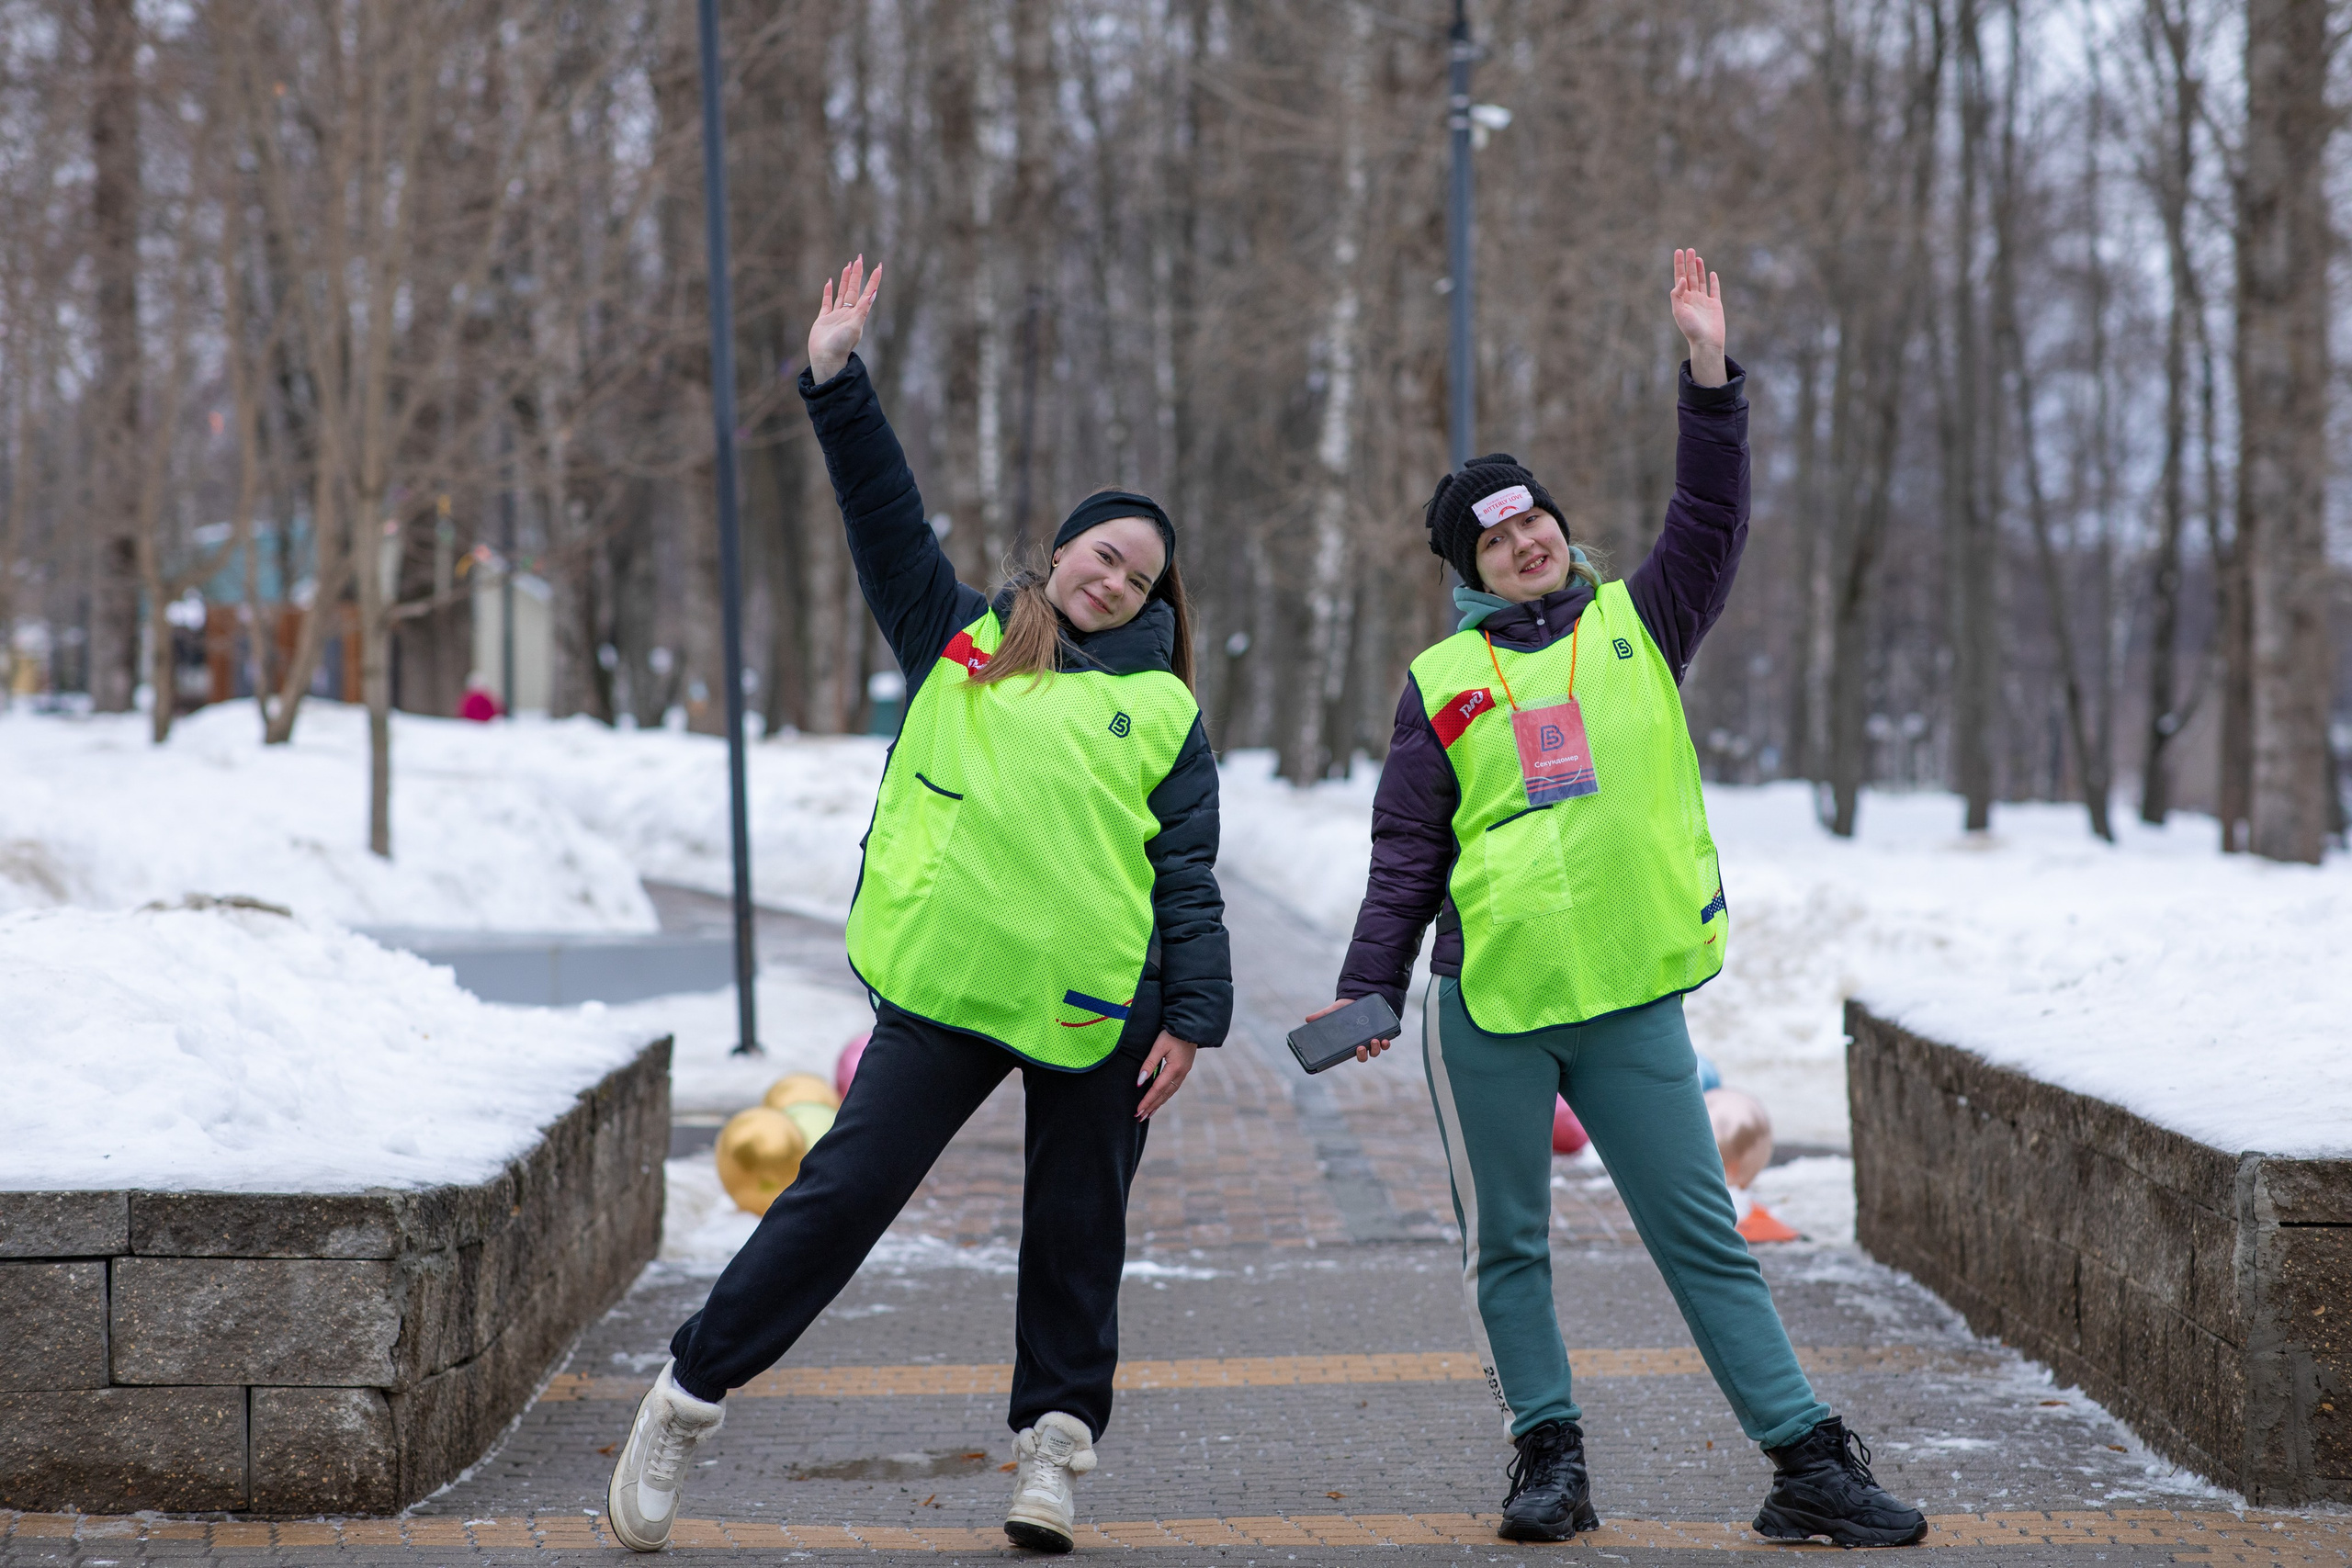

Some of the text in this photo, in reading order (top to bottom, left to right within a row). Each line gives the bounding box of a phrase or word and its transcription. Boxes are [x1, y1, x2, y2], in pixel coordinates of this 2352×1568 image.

[1483, 498, 1508, 514] BITTERLY
[1508, 493, 1523, 502] LOVE
[1534, 754, 1579, 769] Секундомер
